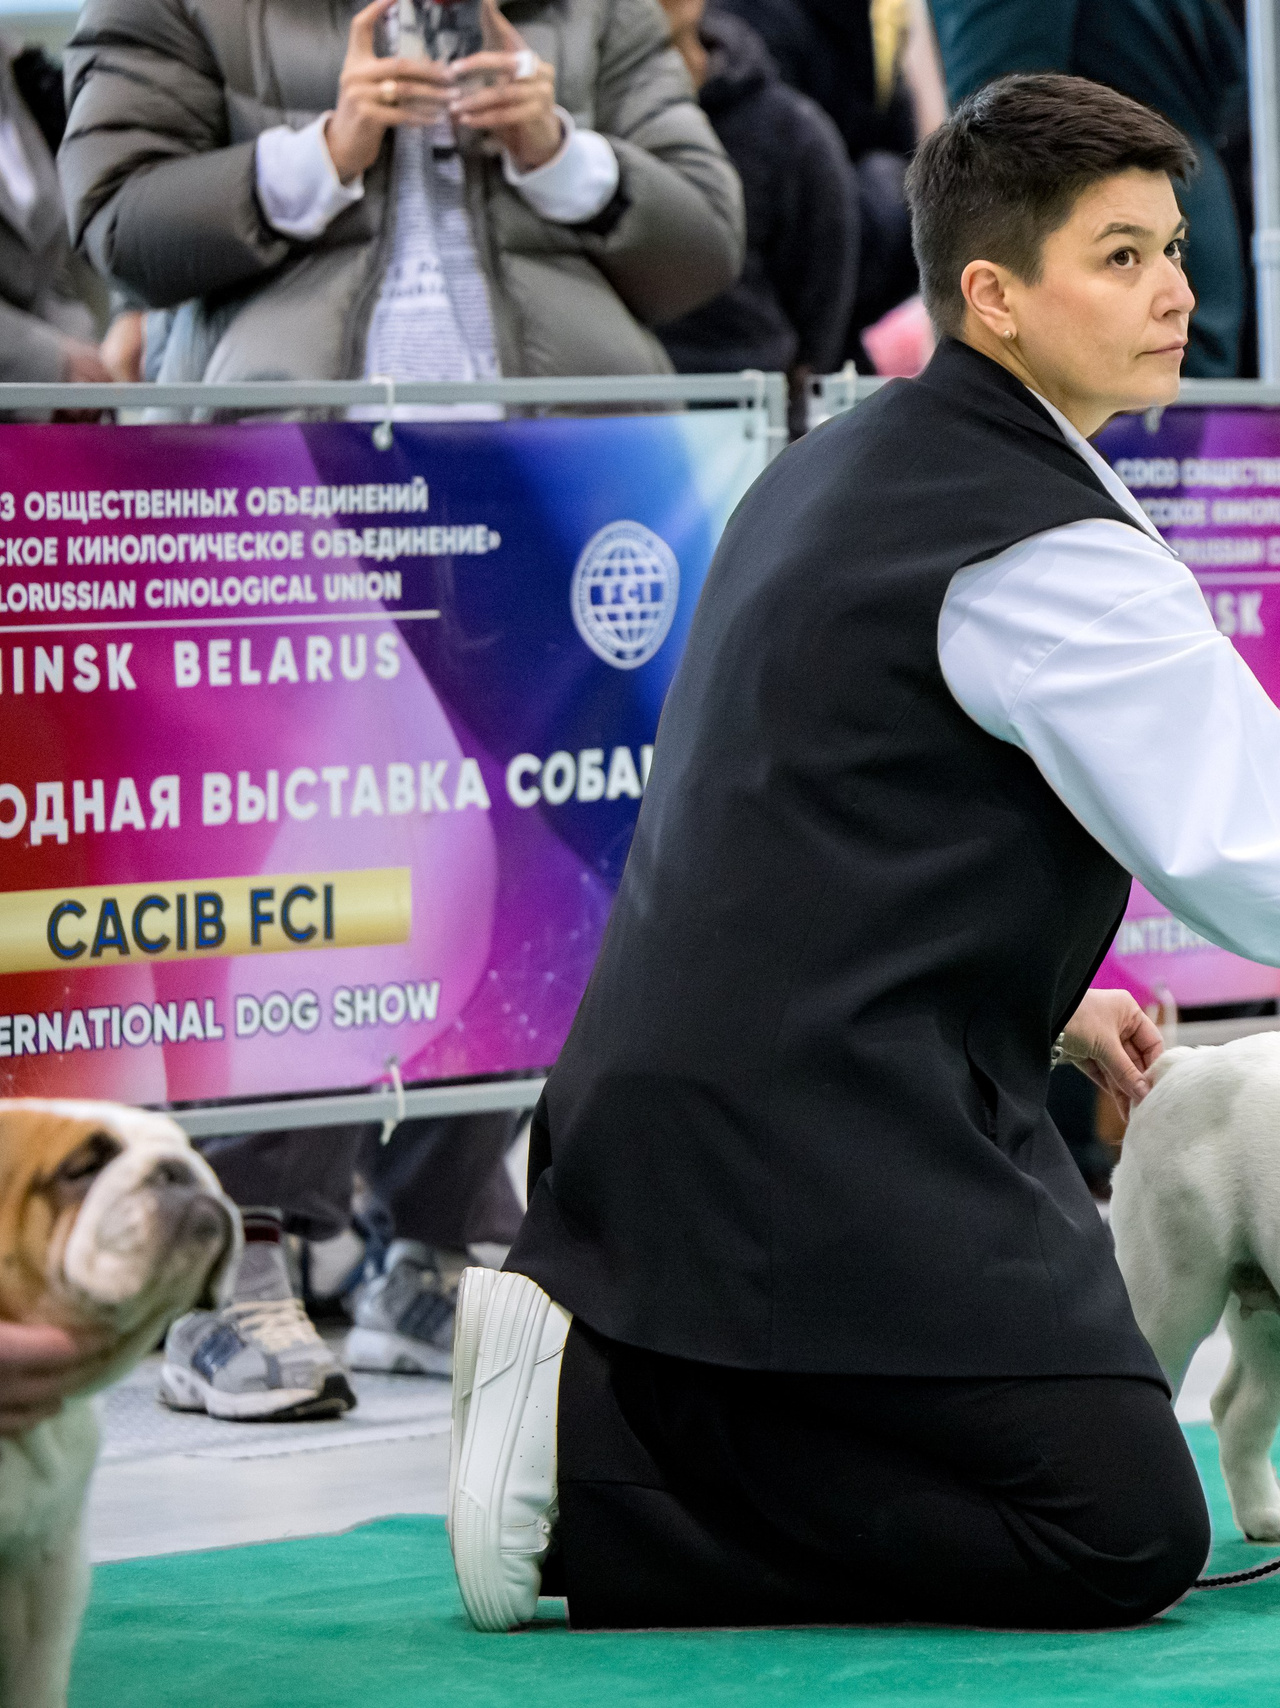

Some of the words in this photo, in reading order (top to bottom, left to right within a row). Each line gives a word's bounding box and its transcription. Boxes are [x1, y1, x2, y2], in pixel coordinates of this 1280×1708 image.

[24, 488, 239, 525] ОБЩЕСТВЕННЫХ
[246, 475, 429, 518] ОБЪЕДИНЕНИЙ
[66, 530, 304, 566] КИНОЛОГИЧЕСКОЕ
[311, 523, 501, 562] ОБЪЕДИНЕНИЕ»
[145, 574, 318, 609] CINOLOGICAL
[323, 570, 402, 603] UNION
[0, 642, 138, 695] INSK
[173, 631, 401, 689] BELARUS
[202, 757, 492, 827] ВЫСТАВКА
[46, 891, 226, 961] CACIB
[249, 883, 335, 947] FCI
[0, 999, 225, 1058] ERNATIONAL
[234, 988, 320, 1037] DOG
[332, 980, 442, 1028] SHOW
